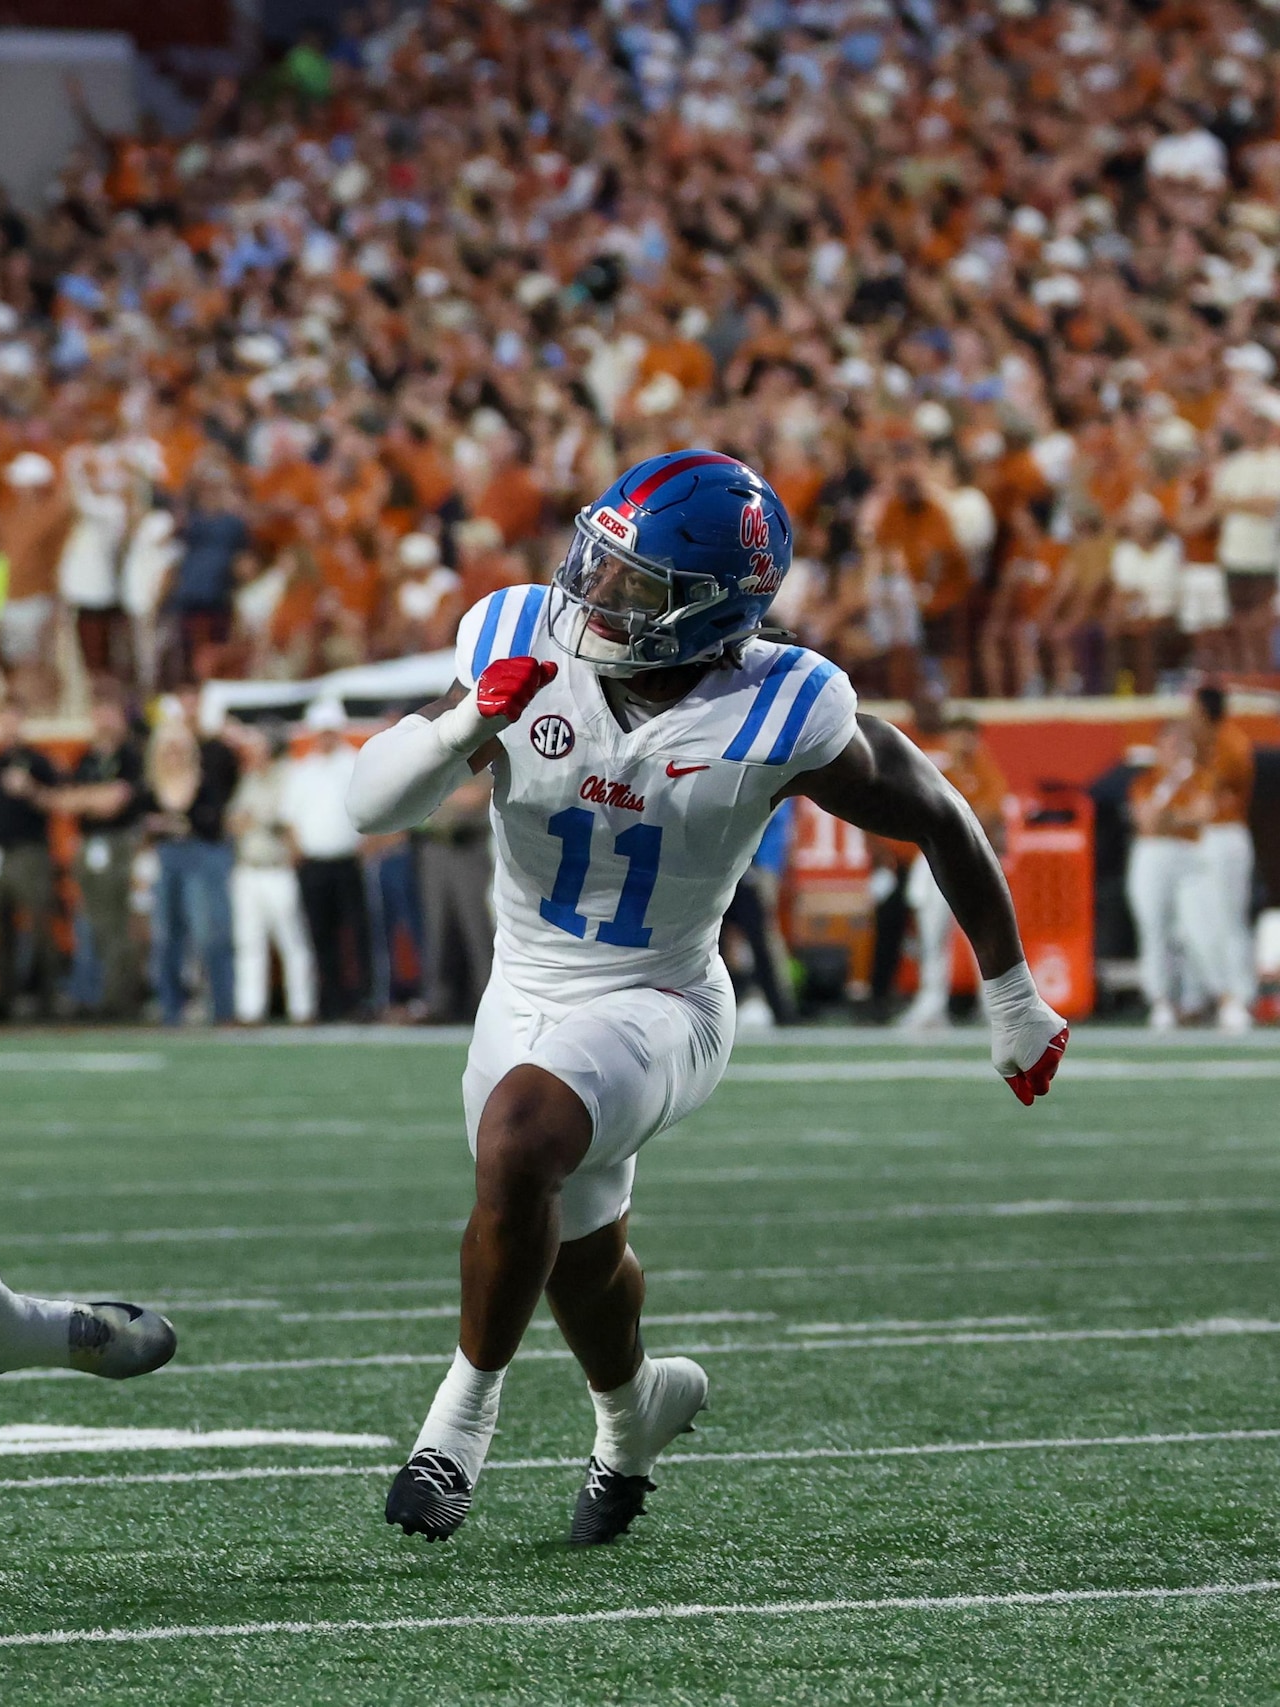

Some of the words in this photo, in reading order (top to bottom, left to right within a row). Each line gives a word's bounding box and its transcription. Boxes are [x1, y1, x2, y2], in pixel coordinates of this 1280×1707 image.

[597, 511, 629, 539] REBS
[740, 504, 769, 550] Ole
[741, 551, 783, 596] Miss
[532, 716, 572, 756] SEC
[580, 775, 606, 804] Ole
[604, 781, 645, 812] Miss
[539, 806, 663, 949] 11
